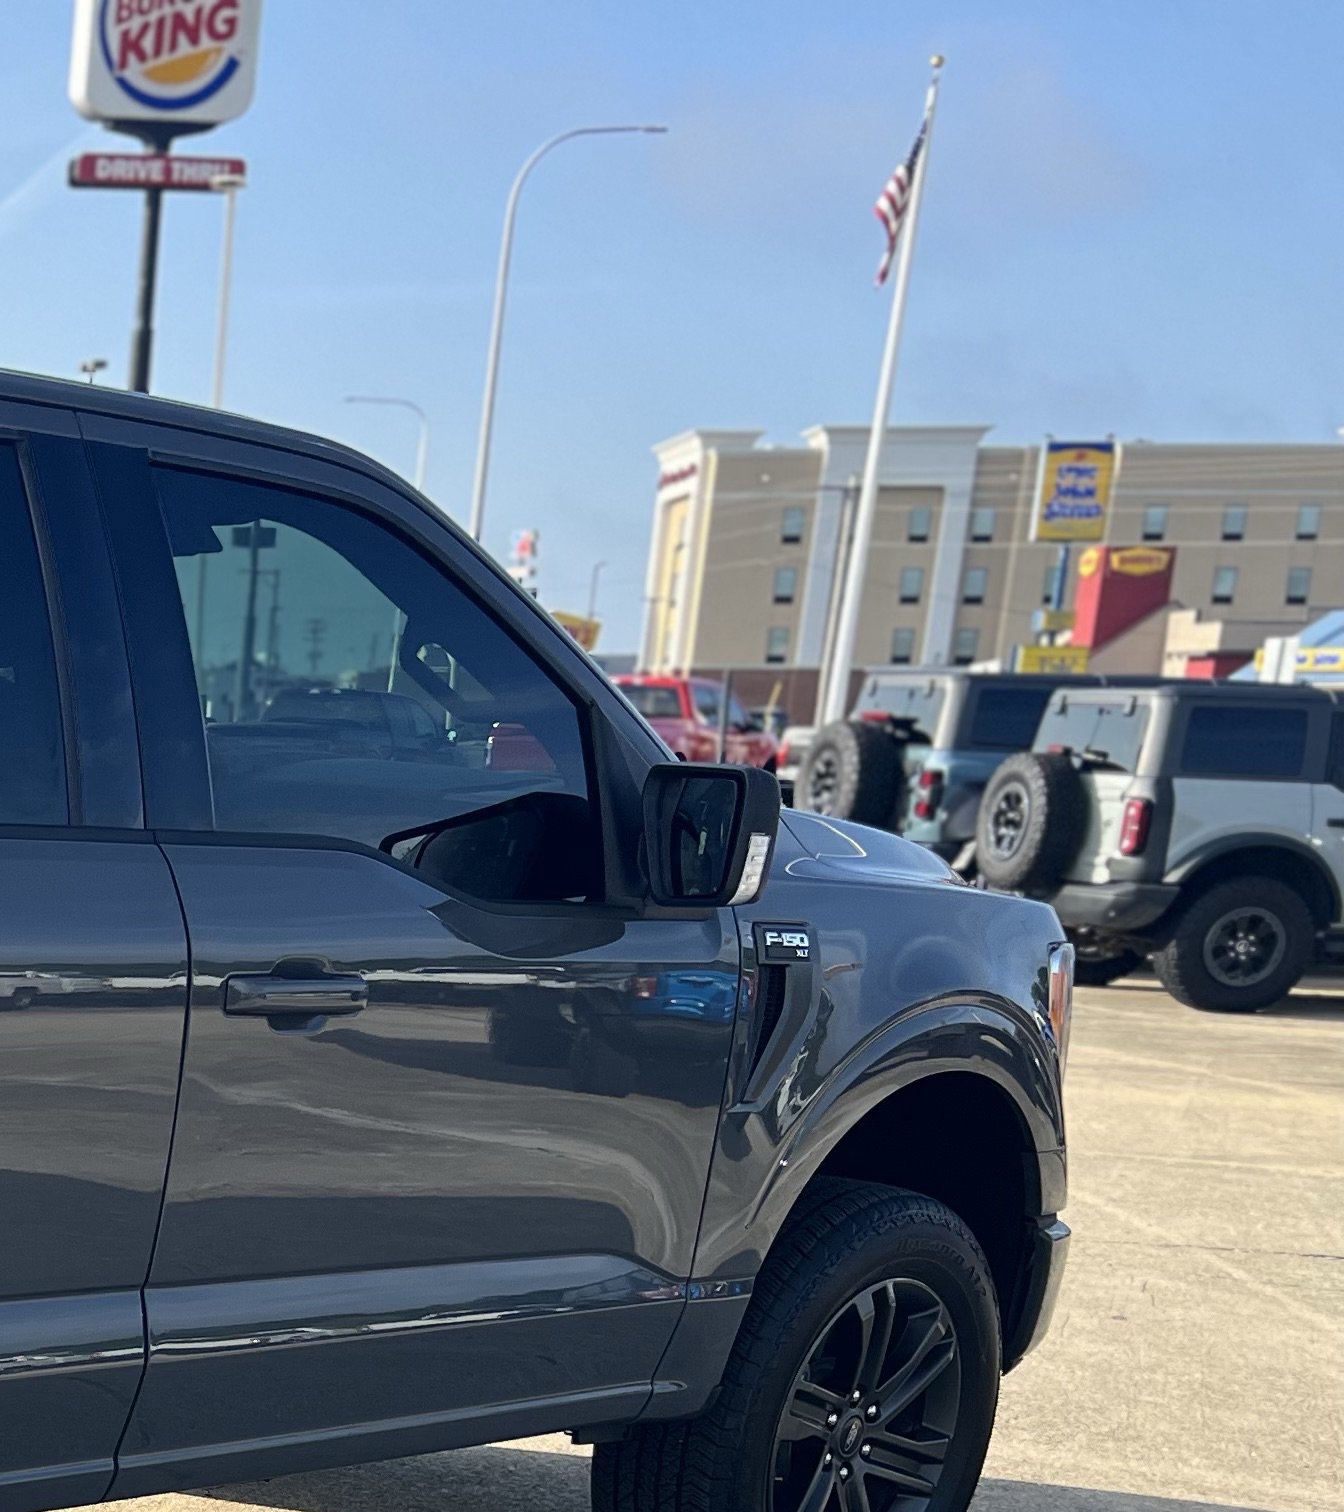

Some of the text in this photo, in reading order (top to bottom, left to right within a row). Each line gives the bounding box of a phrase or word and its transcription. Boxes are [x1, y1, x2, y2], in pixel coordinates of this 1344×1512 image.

[118, 0, 239, 71] KING
[95, 157, 166, 183] DRIVE
[765, 931, 810, 947] F-150
[795, 949, 809, 957] XLT
